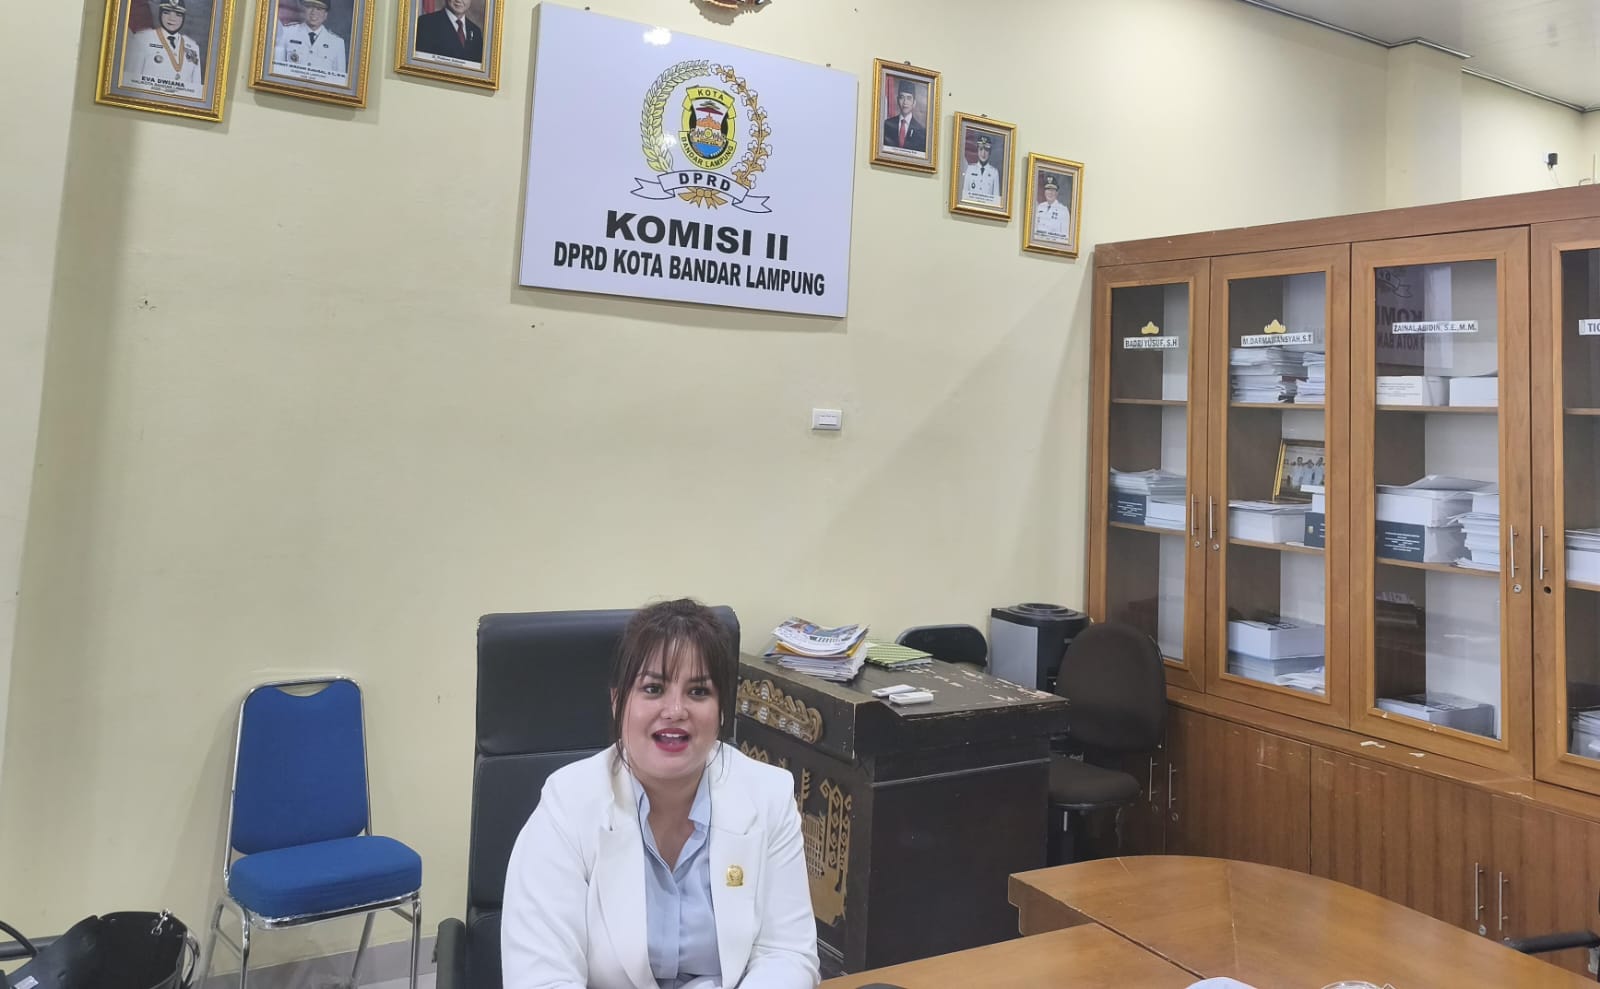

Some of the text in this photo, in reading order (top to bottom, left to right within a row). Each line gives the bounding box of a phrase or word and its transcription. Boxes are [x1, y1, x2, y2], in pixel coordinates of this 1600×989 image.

[141, 75, 185, 87] EVA DWIANA
[698, 89, 724, 101] KOTA
[681, 136, 734, 168] BANDAR LAMPUNG
[679, 172, 731, 192] DPRD
[606, 210, 789, 261] KOMISI II
[553, 241, 825, 296] DPRD KOTA BANDAR LAMPUNG
